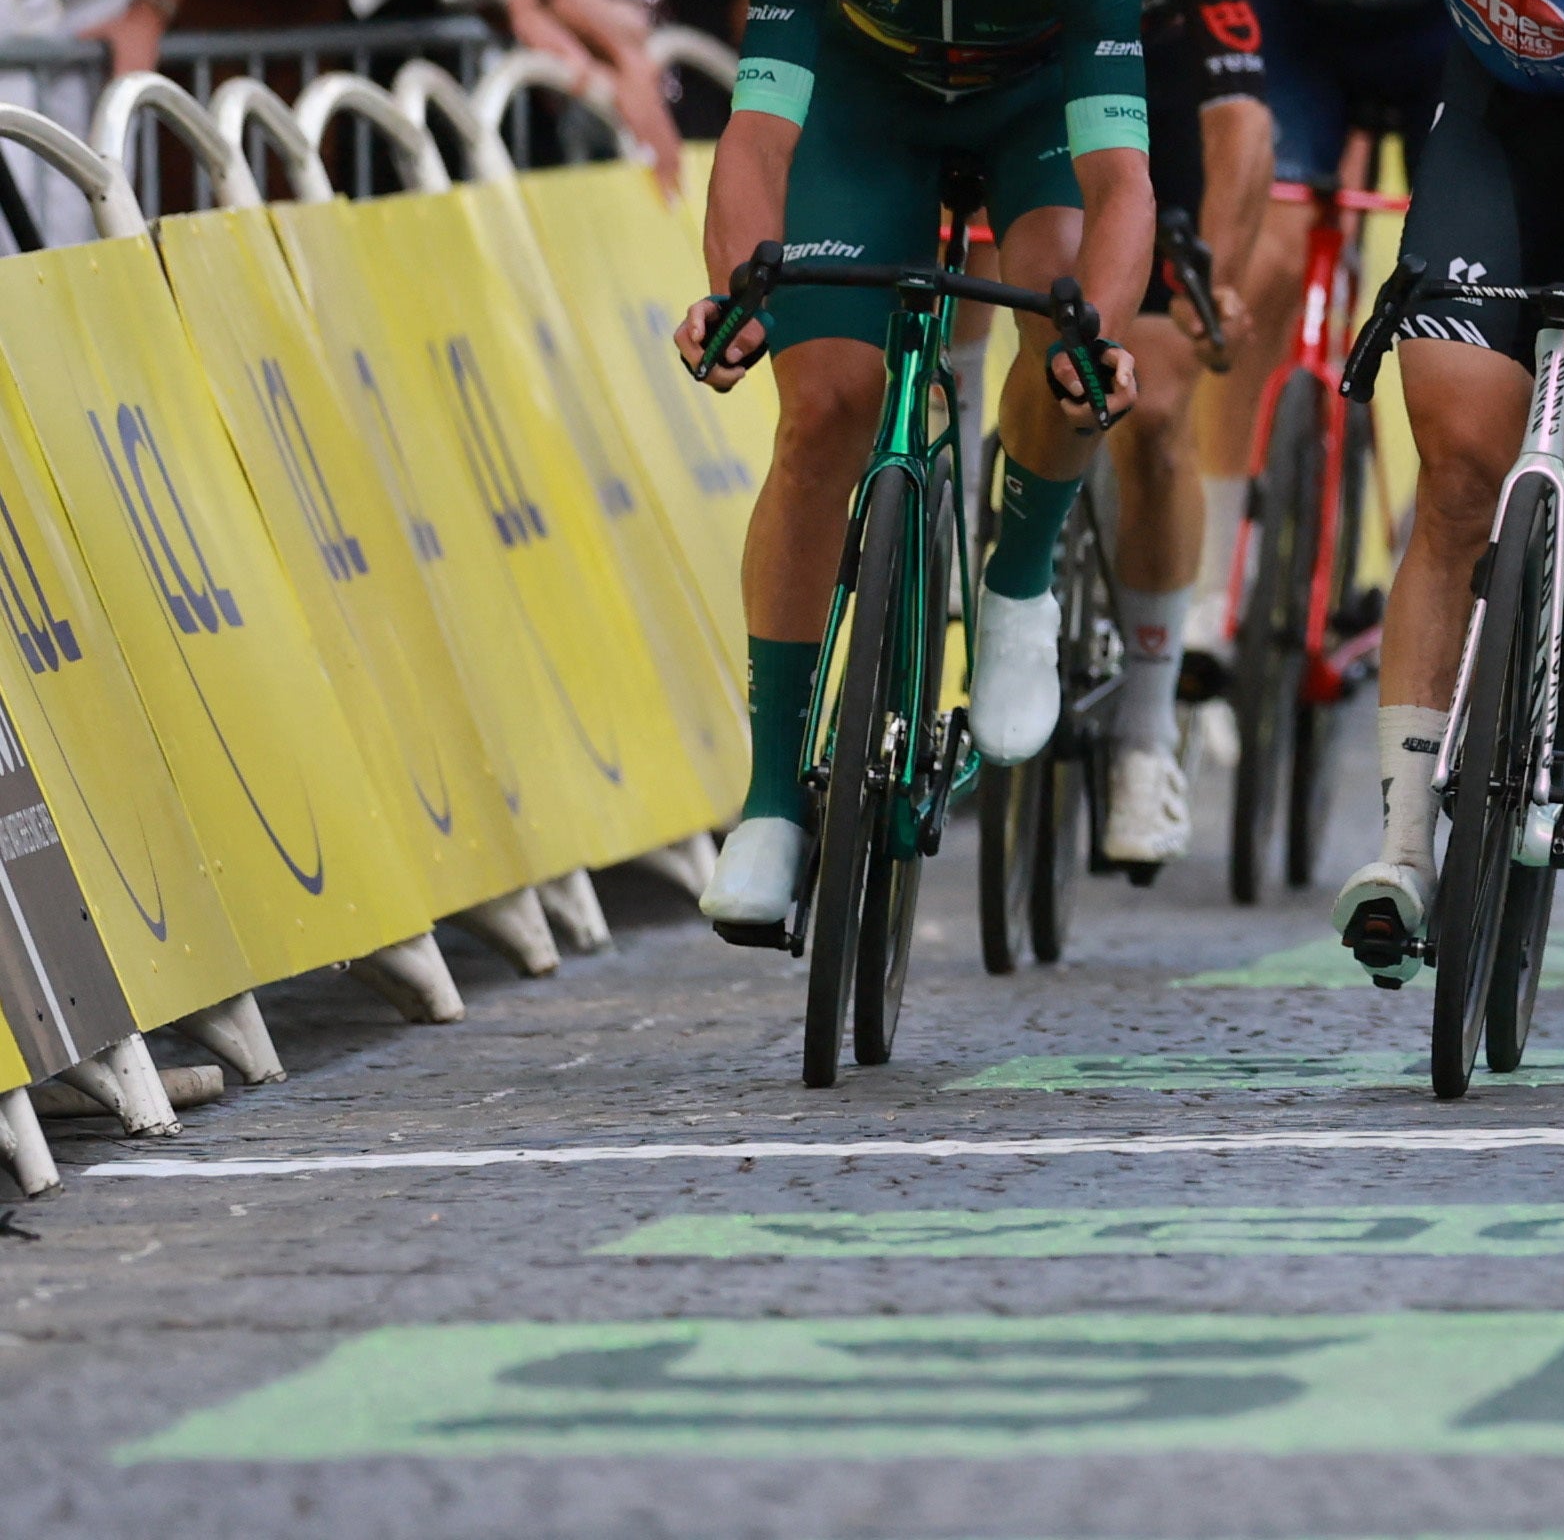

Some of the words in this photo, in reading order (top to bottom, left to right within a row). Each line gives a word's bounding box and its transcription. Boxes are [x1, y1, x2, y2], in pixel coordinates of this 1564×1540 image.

[746, 4, 796, 21] antini
[1502, 25, 1552, 50] DMG
[736, 69, 778, 83] ODA
[1460, 283, 1530, 301] CANYON
[1531, 348, 1556, 436] CANYON
[86, 402, 244, 634] LCL
